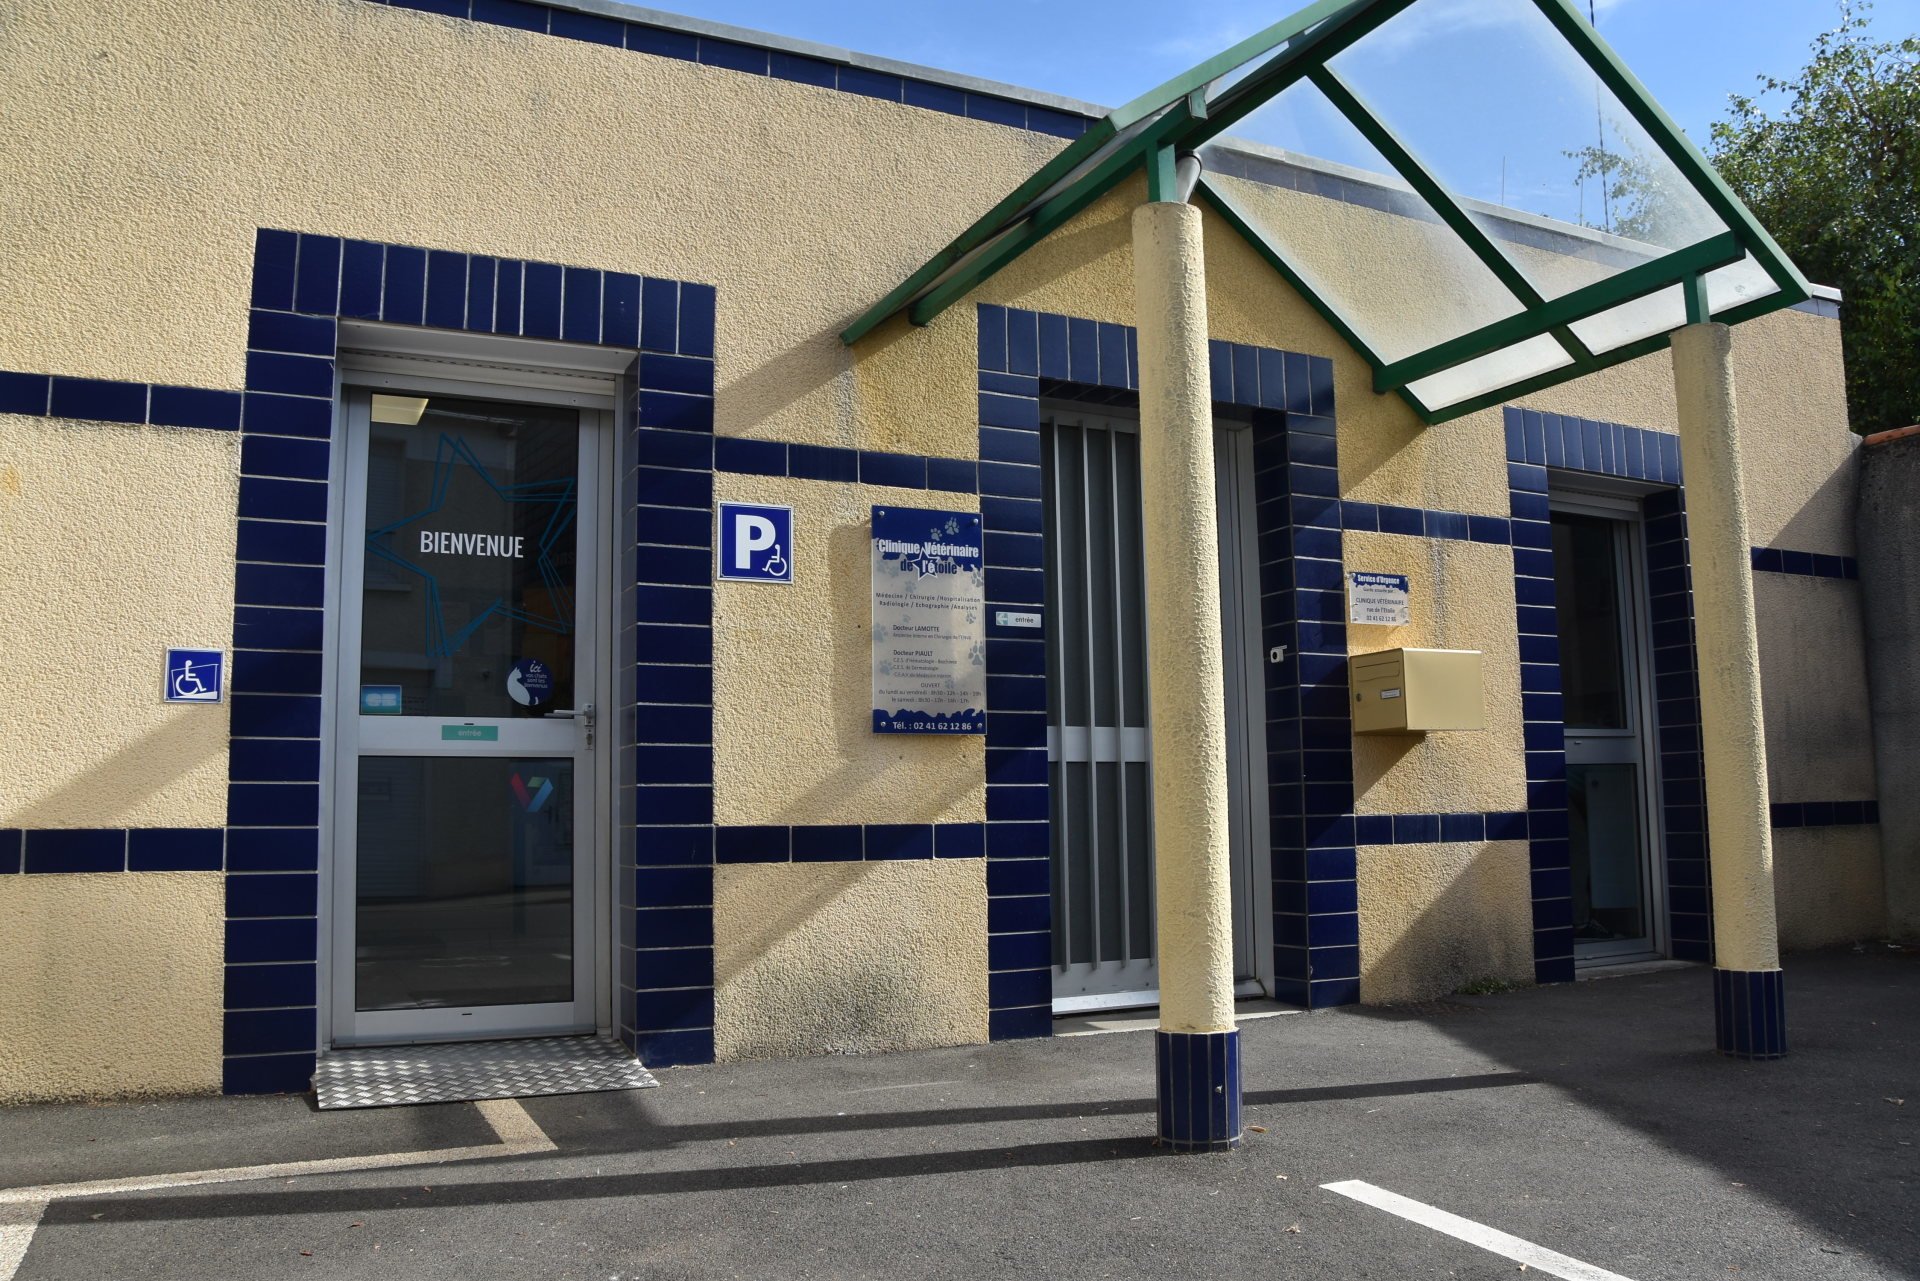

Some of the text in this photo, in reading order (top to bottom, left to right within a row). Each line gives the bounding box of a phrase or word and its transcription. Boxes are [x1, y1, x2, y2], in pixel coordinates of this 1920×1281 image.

[420, 530, 524, 559] BIENVENUE
[736, 514, 776, 569] P
[878, 538, 979, 558] Clinique Vétérinaire
[901, 559, 913, 572] de
[1357, 574, 1376, 583] Service
[876, 592, 903, 600] Médecine
[910, 594, 935, 602] Chirurgie
[1356, 597, 1376, 605] CLINIQUE
[879, 600, 909, 609] Radiologie
[1015, 616, 1034, 624] entrée
[530, 660, 543, 673] ici
[892, 721, 907, 730] Tél.
[913, 722, 924, 730] 02
[925, 722, 935, 730] 41
[937, 722, 948, 730] 62
[950, 722, 960, 730] 12
[961, 723, 972, 731] 86
[458, 729, 482, 737] entrée
